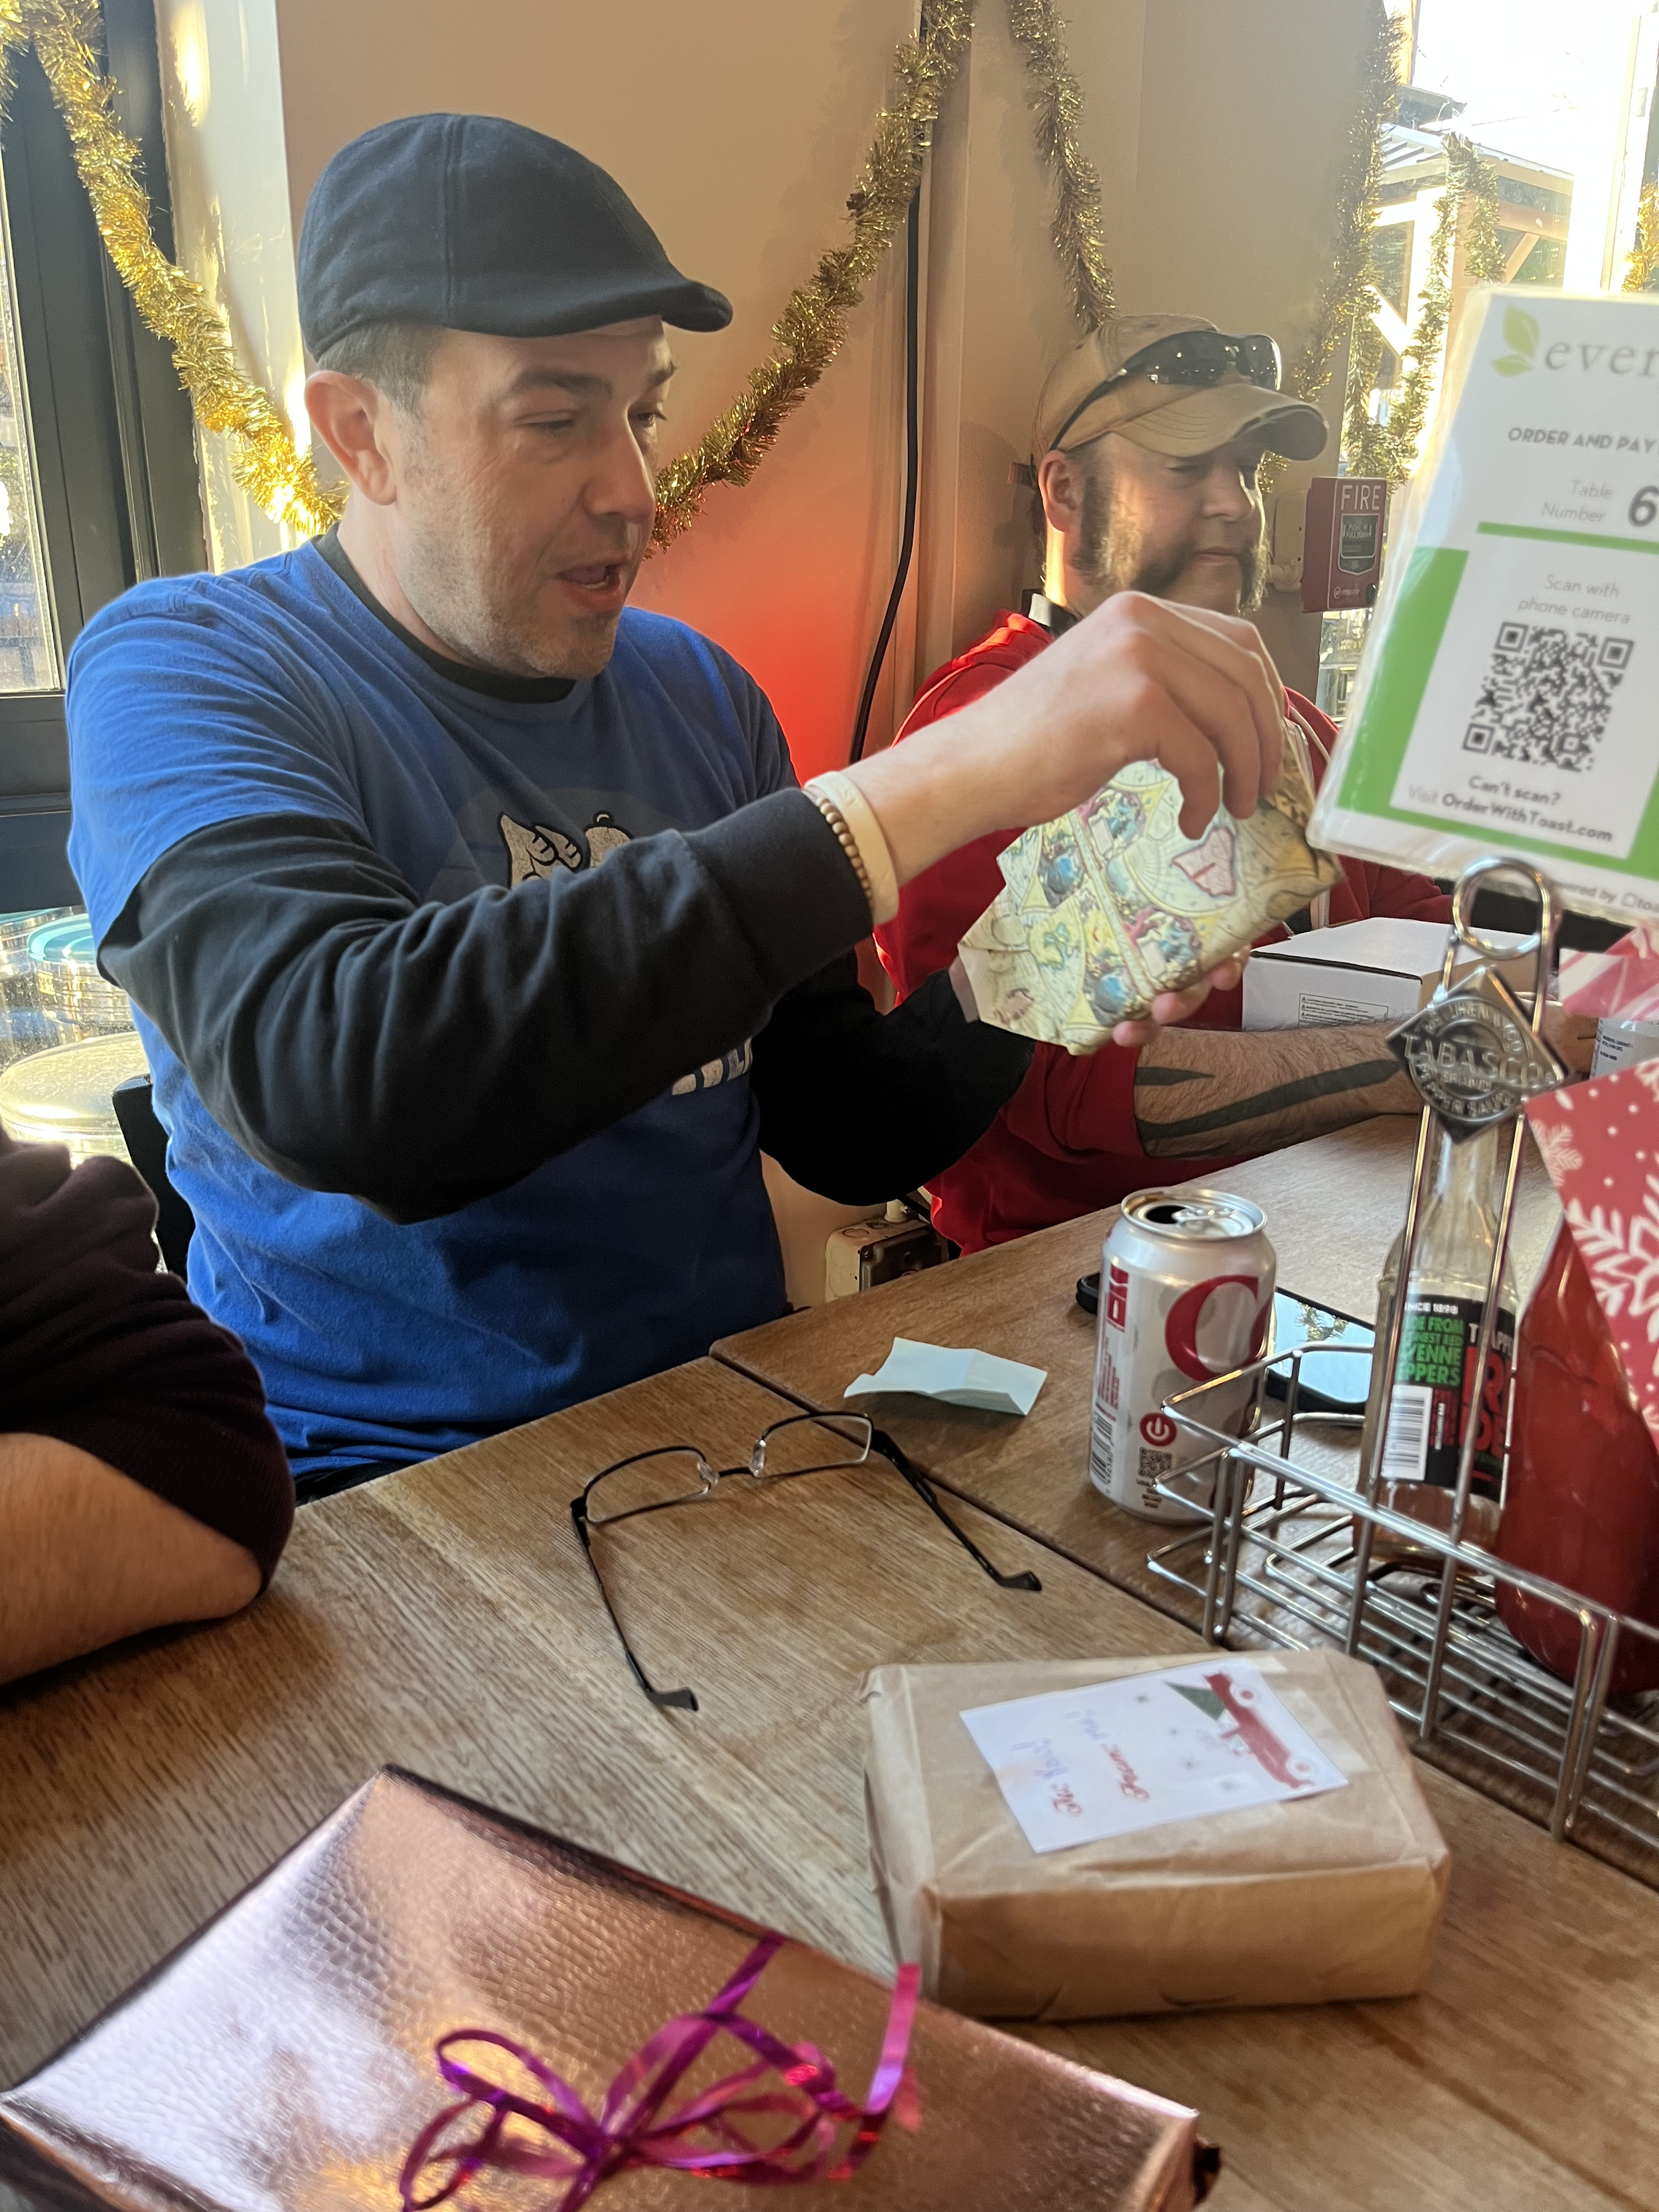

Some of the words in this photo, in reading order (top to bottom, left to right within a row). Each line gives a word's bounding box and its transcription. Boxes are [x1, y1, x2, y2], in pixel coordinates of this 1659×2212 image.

[1508, 427, 1569, 445] ORDER
[1572, 433, 1613, 449] AND
[1616, 435, 1658, 453] PAY
[1341, 484, 1381, 511] FIRE
[1571, 479, 1613, 499] Table
[1541, 502, 1606, 522] Number
[1628, 484, 1659, 528] 6
[1543, 573, 1581, 593] Scan
[1587, 582, 1620, 599] with
[1517, 596, 1567, 616] phone
[1571, 607, 1630, 625] camera
[1468, 774, 1511, 797] Can't
[1514, 788, 1561, 806] scan?
[1442, 792, 1613, 842] OrderWithToast.com
[1400, 1032, 1544, 1090] TABASCO
[1404, 1302, 1431, 1313] INCE
[1396, 1362, 1461, 1387] EPPERS
